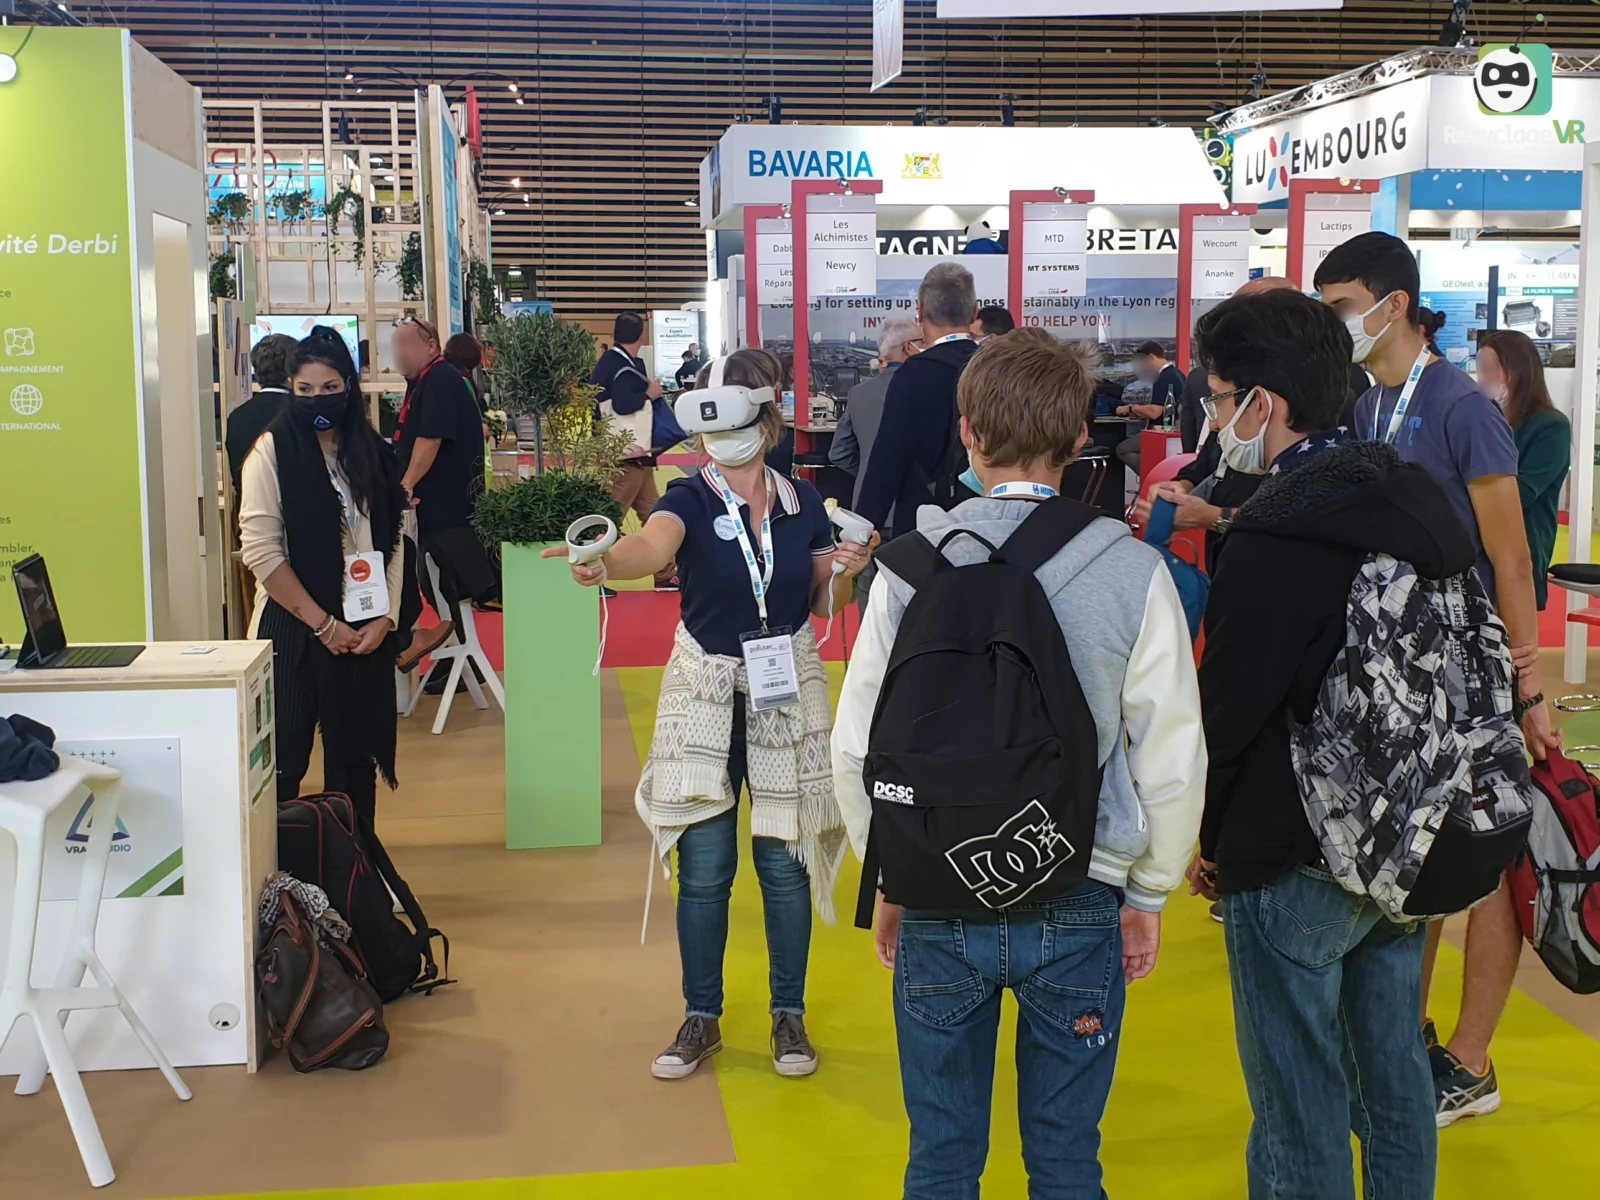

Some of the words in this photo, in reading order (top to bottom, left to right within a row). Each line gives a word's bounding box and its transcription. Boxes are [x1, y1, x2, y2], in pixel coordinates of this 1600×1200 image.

[1246, 111, 1406, 190] LUXEMBOURG
[749, 150, 874, 177] BAVARIA
[1051, 206, 1058, 216] 5
[833, 220, 849, 229] Les
[1320, 222, 1353, 232] Lactips
[813, 232, 868, 242] Alchimistes
[1044, 234, 1065, 243] MTD
[0, 233, 38, 254] vité
[48, 233, 118, 254] Derbi
[1203, 240, 1238, 248] Wecount
[826, 261, 857, 272] Newcy
[1041, 264, 1080, 272] SYSTEMS
[780, 268, 793, 277] Les
[1204, 269, 1235, 278] Ananke
[764, 279, 793, 291] Répara
[825, 297, 843, 308] for
[847, 297, 892, 310] setting
[896, 300, 912, 310] up
[1023, 296, 1081, 310] stainably
[1084, 296, 1095, 307] in
[1099, 297, 1118, 307] the
[1123, 297, 1151, 310] Lyon
[1023, 316, 1039, 327] TO
[1043, 316, 1078, 326] HELP
[1081, 316, 1112, 327] YOU!
[0, 365, 65, 373] MPAGNEMENT
[0, 422, 62, 431] TERNATIONAL
[874, 780, 914, 800] DCSC
